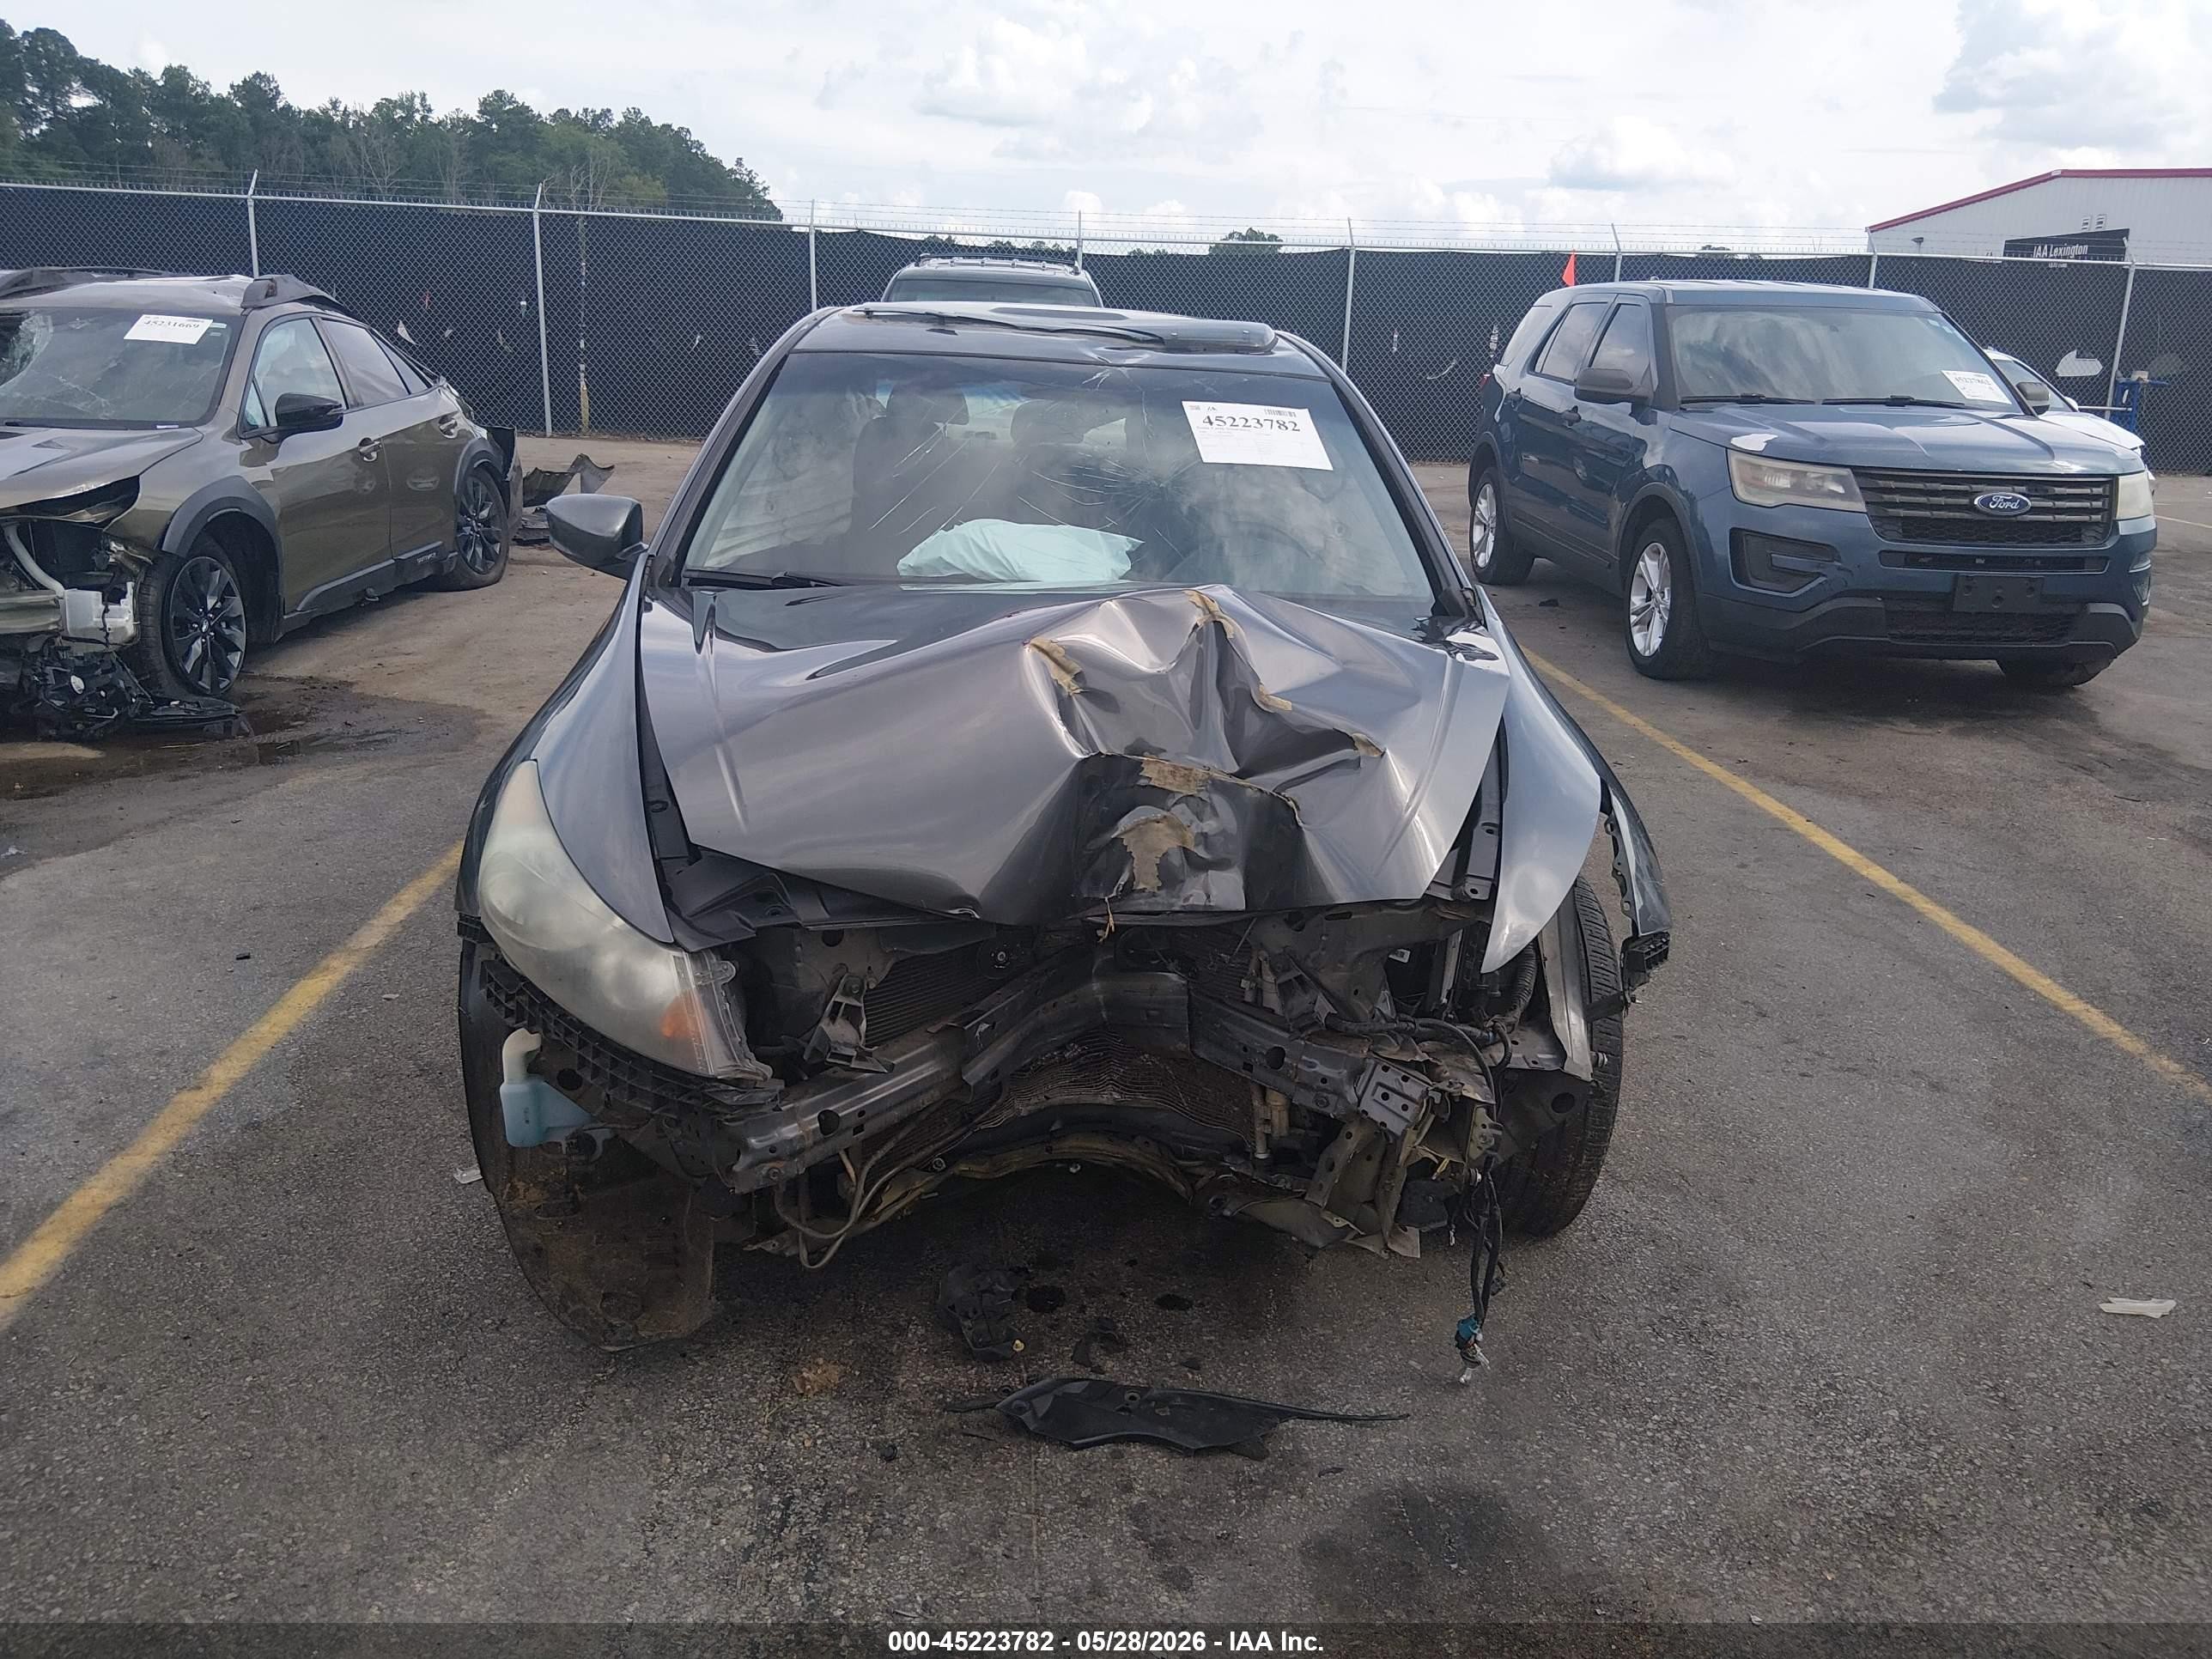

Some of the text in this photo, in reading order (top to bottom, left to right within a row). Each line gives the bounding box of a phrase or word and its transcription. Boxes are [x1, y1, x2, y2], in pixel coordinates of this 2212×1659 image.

[2033, 243, 2088, 258] IAA Lexington
[1202, 415, 1301, 432] 45223782
[1989, 495, 2021, 509] Ford
